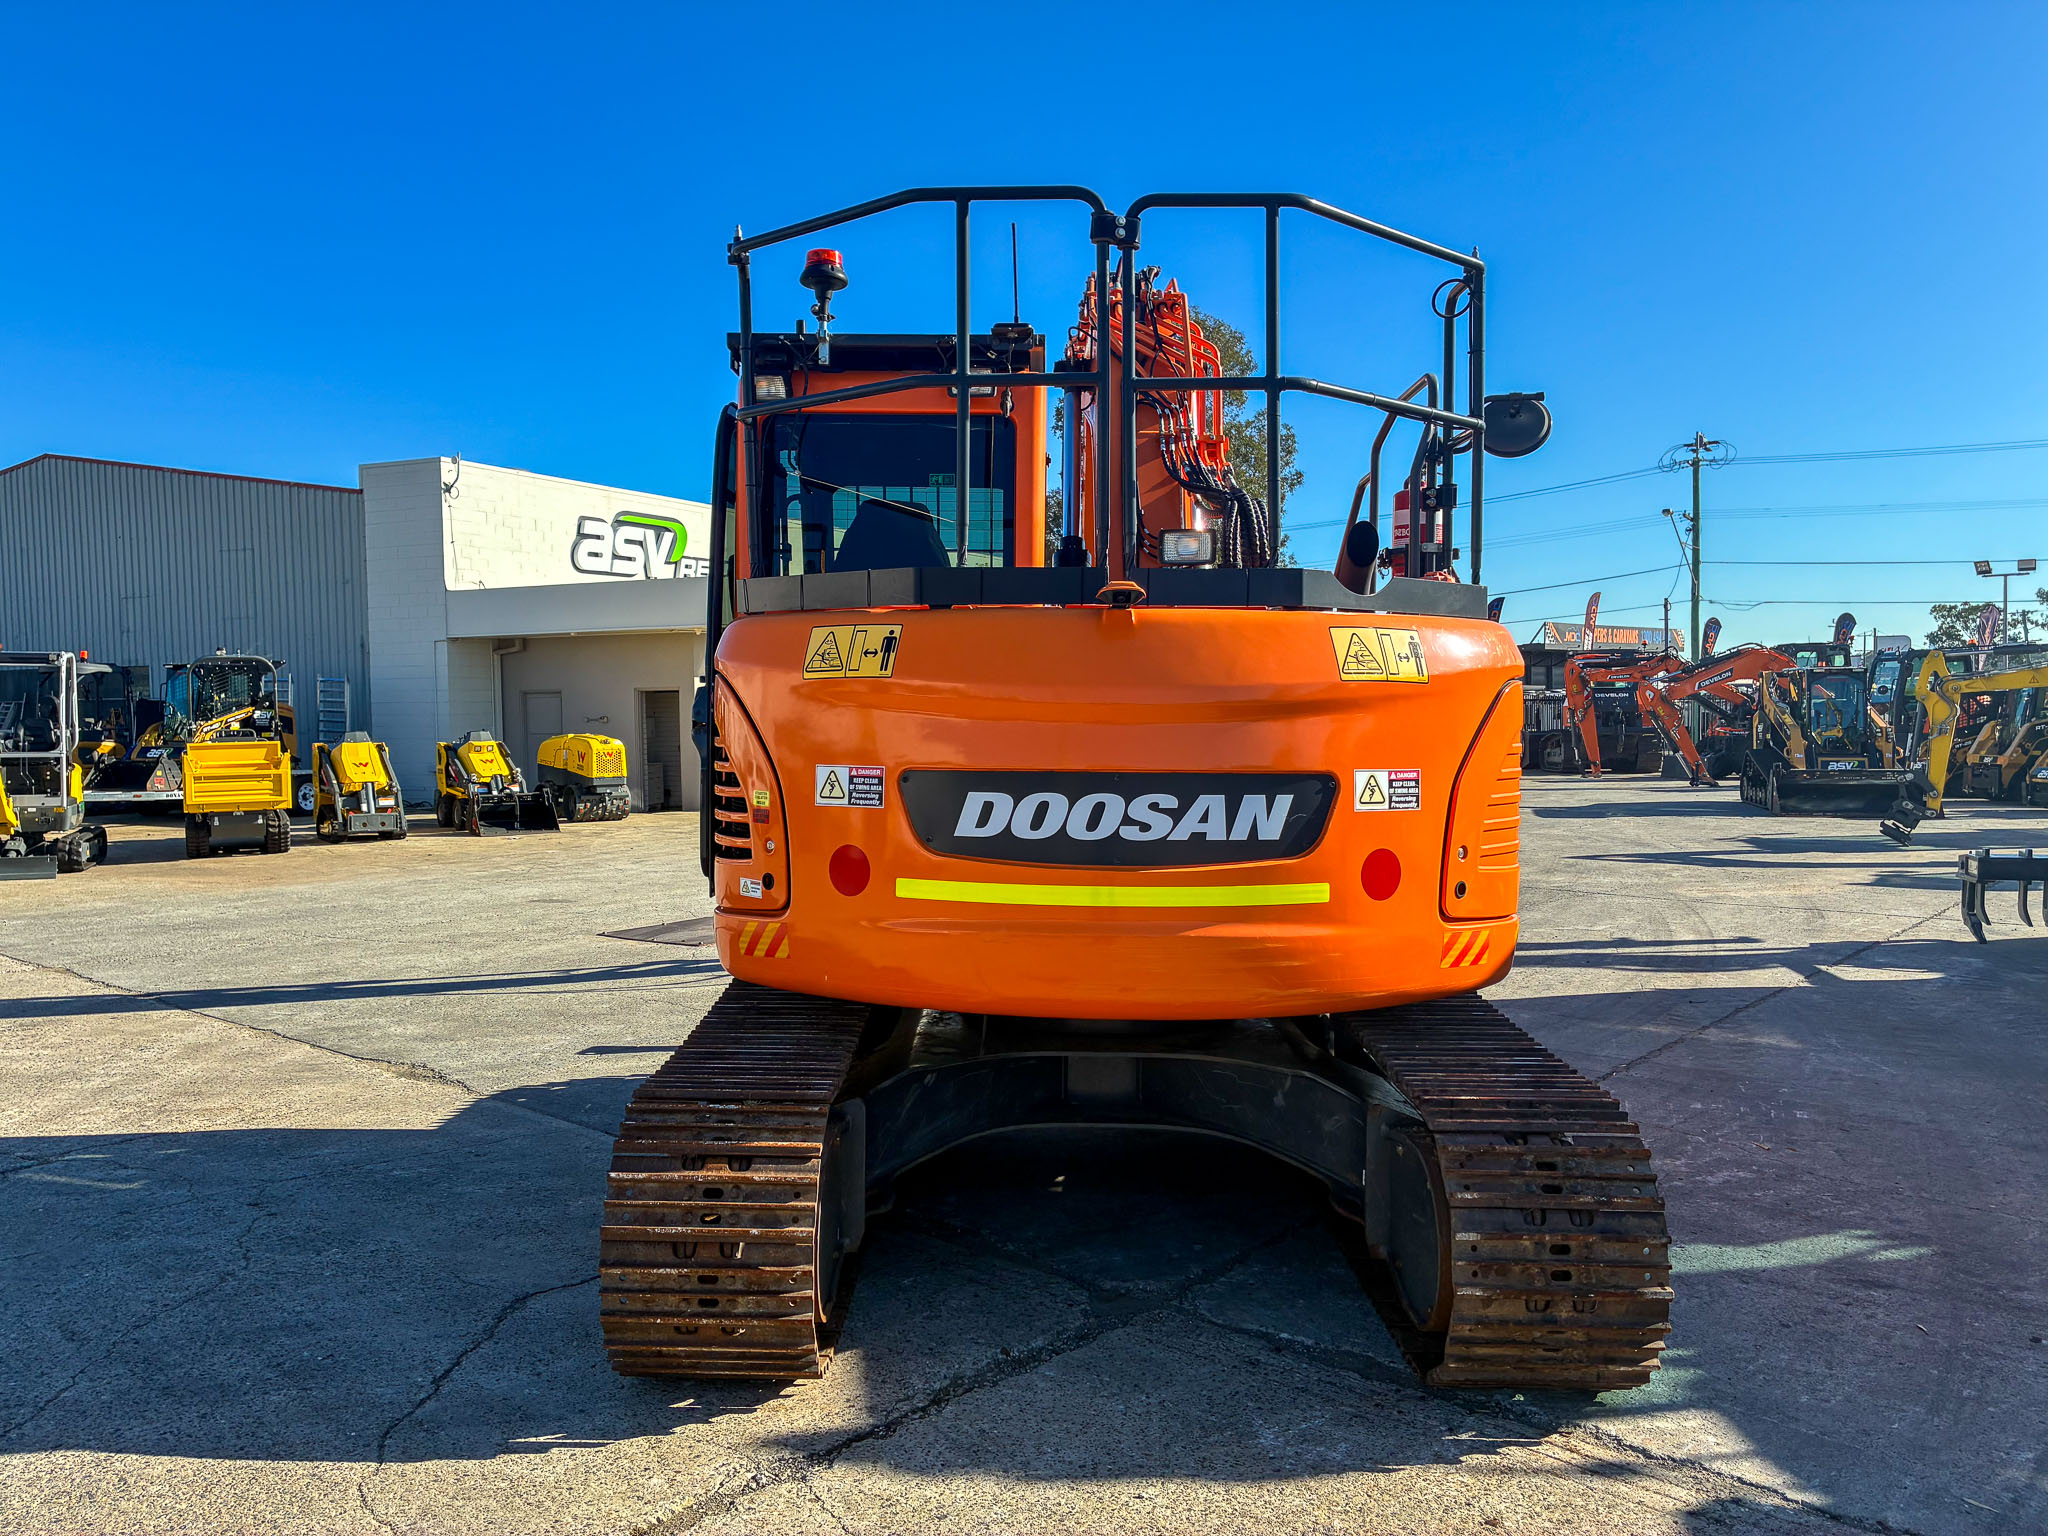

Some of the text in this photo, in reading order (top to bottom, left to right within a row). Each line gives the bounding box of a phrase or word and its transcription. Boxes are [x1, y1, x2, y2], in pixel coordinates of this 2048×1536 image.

[1613, 629, 1639, 645] CARAVANS
[1700, 671, 1732, 688] DEVELON
[852, 792, 879, 800] Reversing
[954, 791, 1295, 841] DOOSAN
